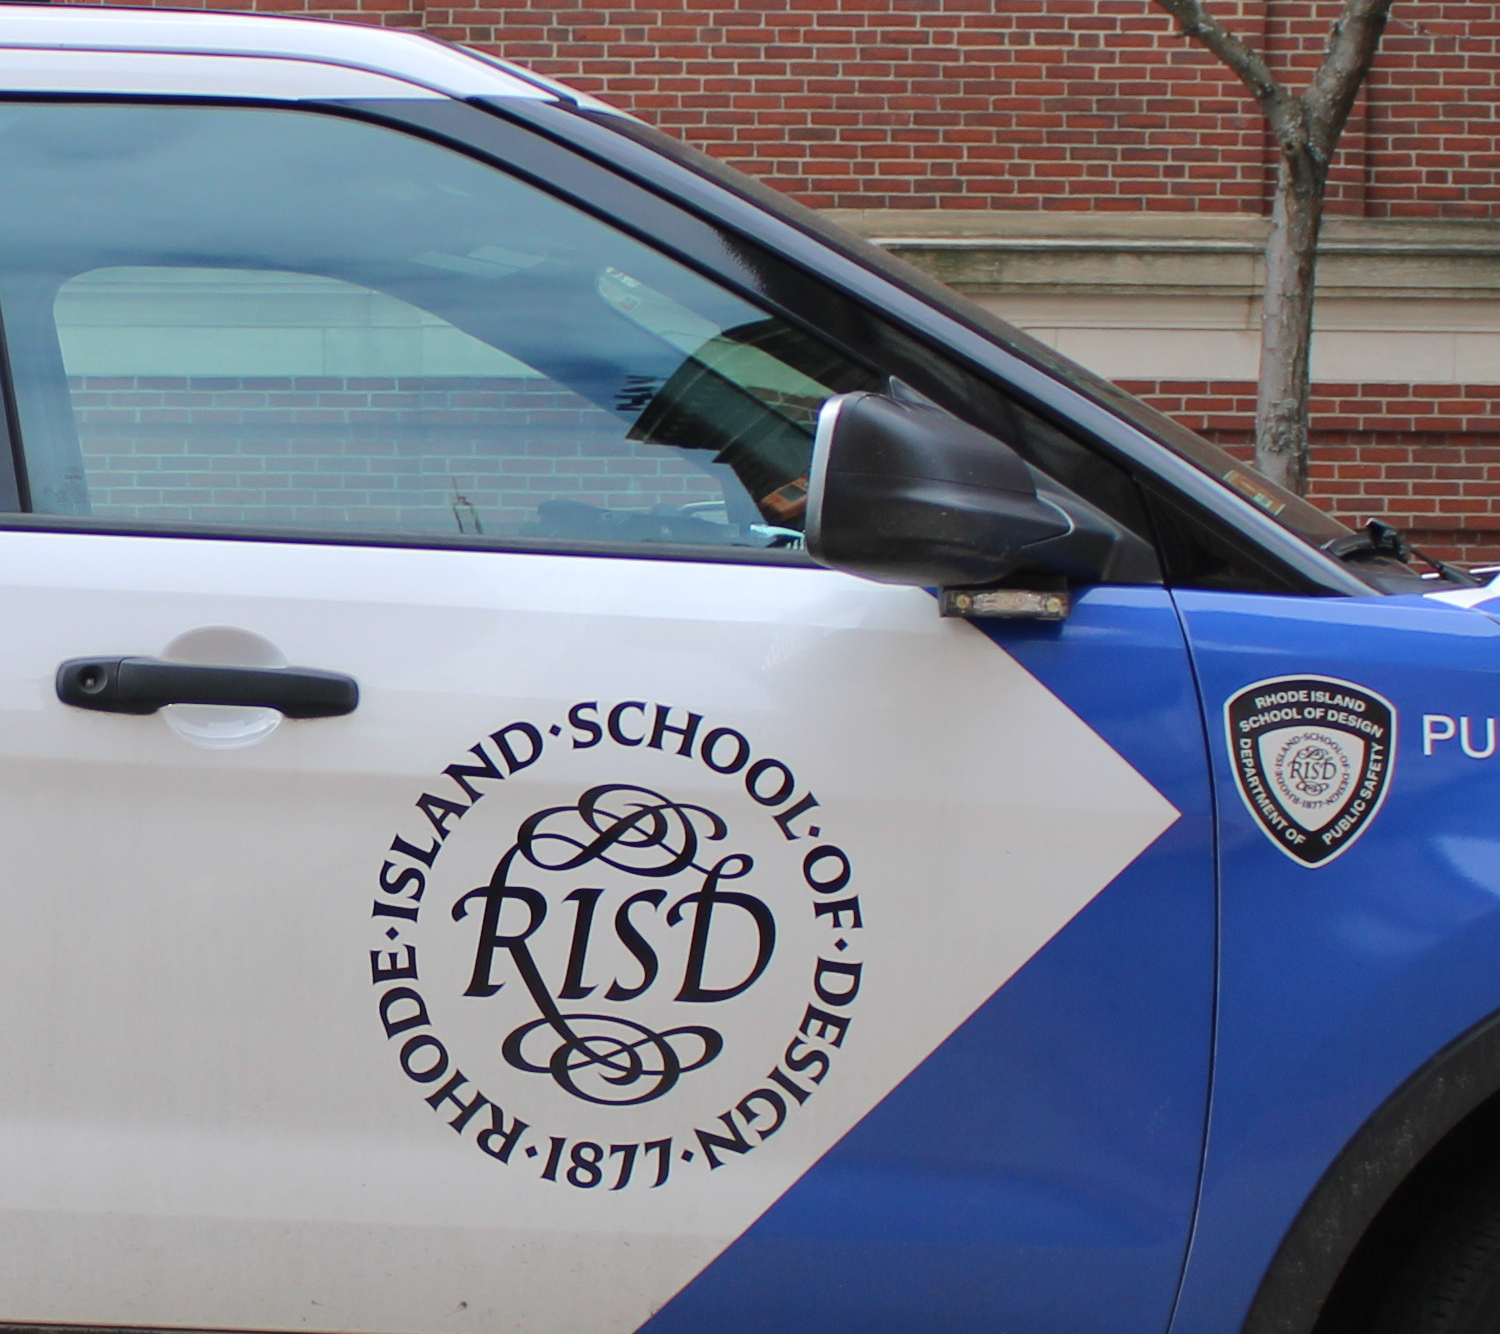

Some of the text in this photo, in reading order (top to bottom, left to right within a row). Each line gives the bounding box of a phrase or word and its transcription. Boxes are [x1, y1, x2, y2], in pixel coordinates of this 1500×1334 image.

[1239, 707, 1384, 739] SCHOOL OF DESIGN
[1254, 690, 1366, 713] RHODE ISLAND
[1275, 735, 1301, 767] ISLAND
[1303, 732, 1342, 755] SCHOOL
[1239, 737, 1307, 846] DEPARTMENT OF
[1321, 741, 1385, 846] PUBLIC SAFETY
[370, 701, 863, 1170] RHODE ISLAND SCHOOL OF DESIGN
[541, 1136, 674, 1191] 1877
